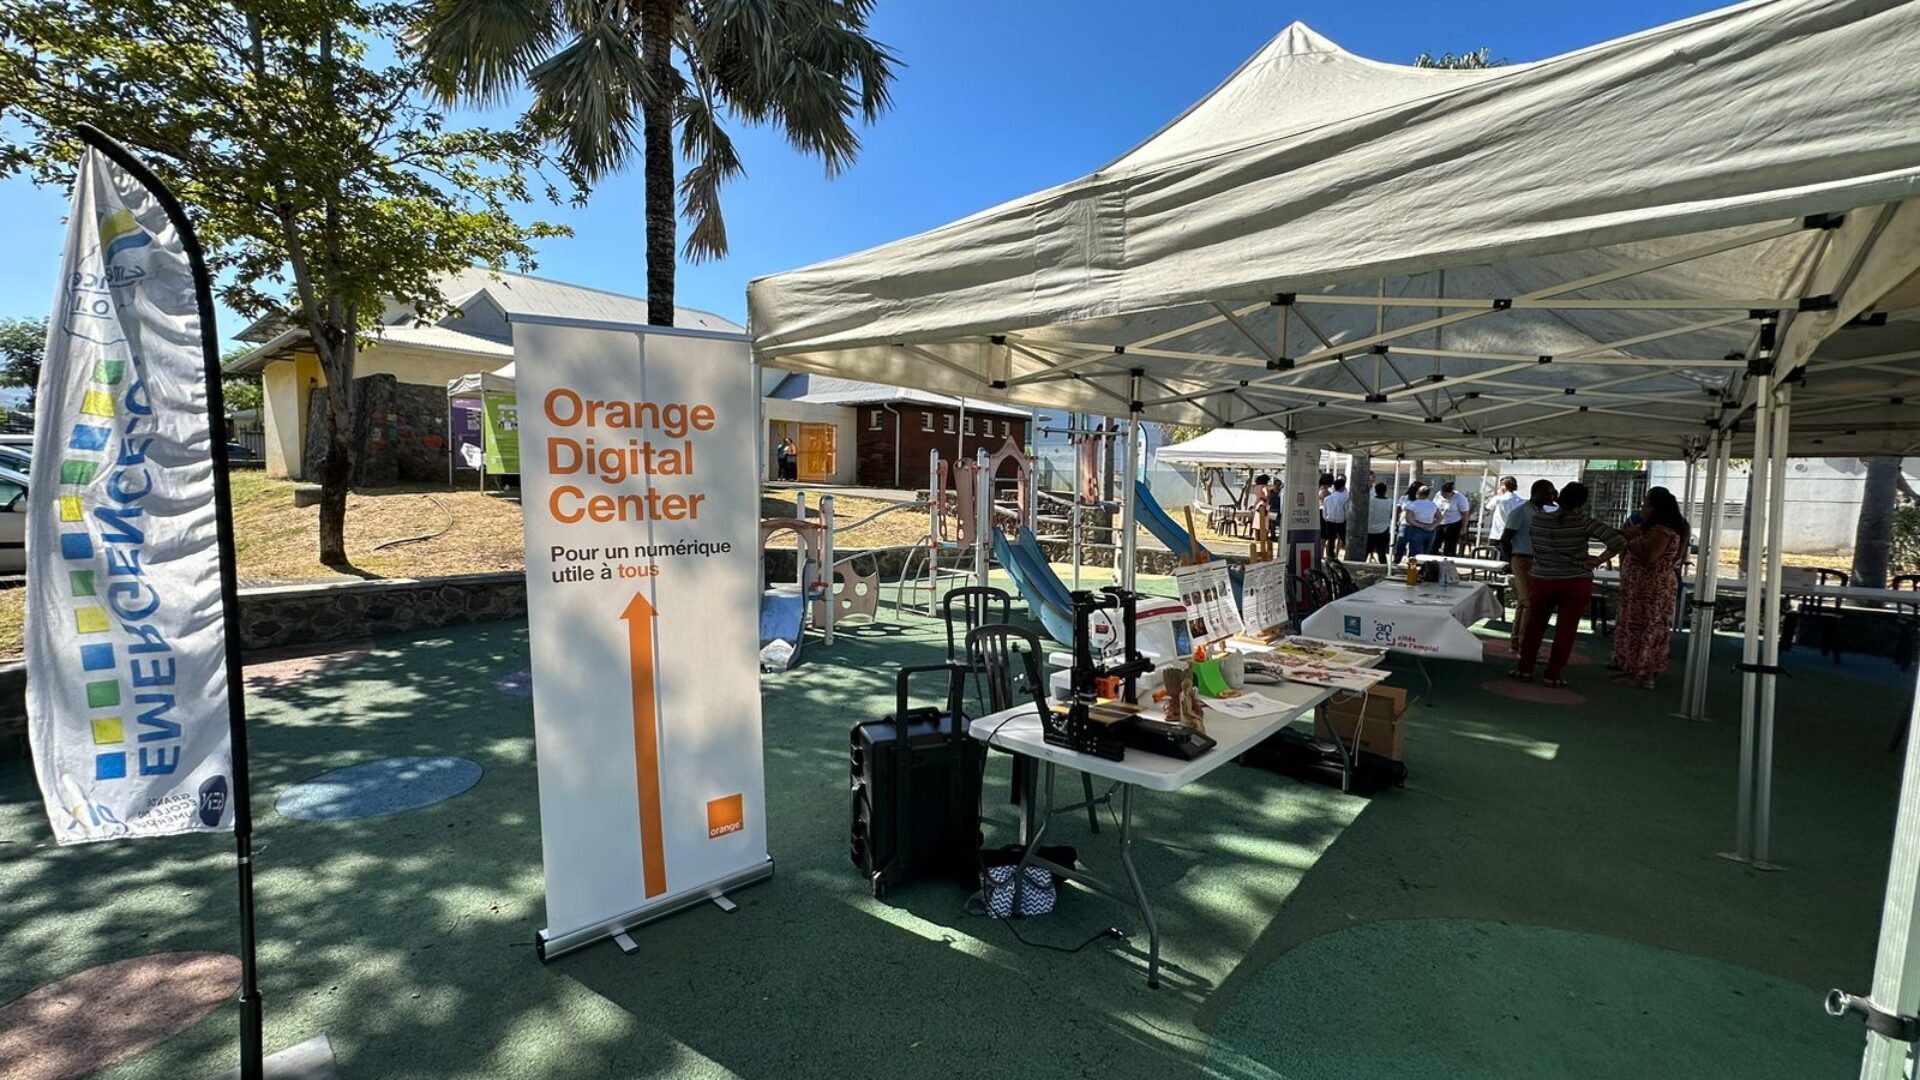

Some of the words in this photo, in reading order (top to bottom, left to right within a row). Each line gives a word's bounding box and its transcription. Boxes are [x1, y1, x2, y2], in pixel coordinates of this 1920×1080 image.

[544, 388, 715, 438] Orange
[547, 437, 693, 484] Digital
[548, 485, 705, 524] Center
[550, 546, 599, 562] Pour
[605, 546, 629, 560] un
[635, 539, 731, 560] numérique
[551, 565, 594, 583] utile
[600, 563, 612, 580] à
[617, 563, 660, 579] tous
[709, 821, 741, 836] orange
